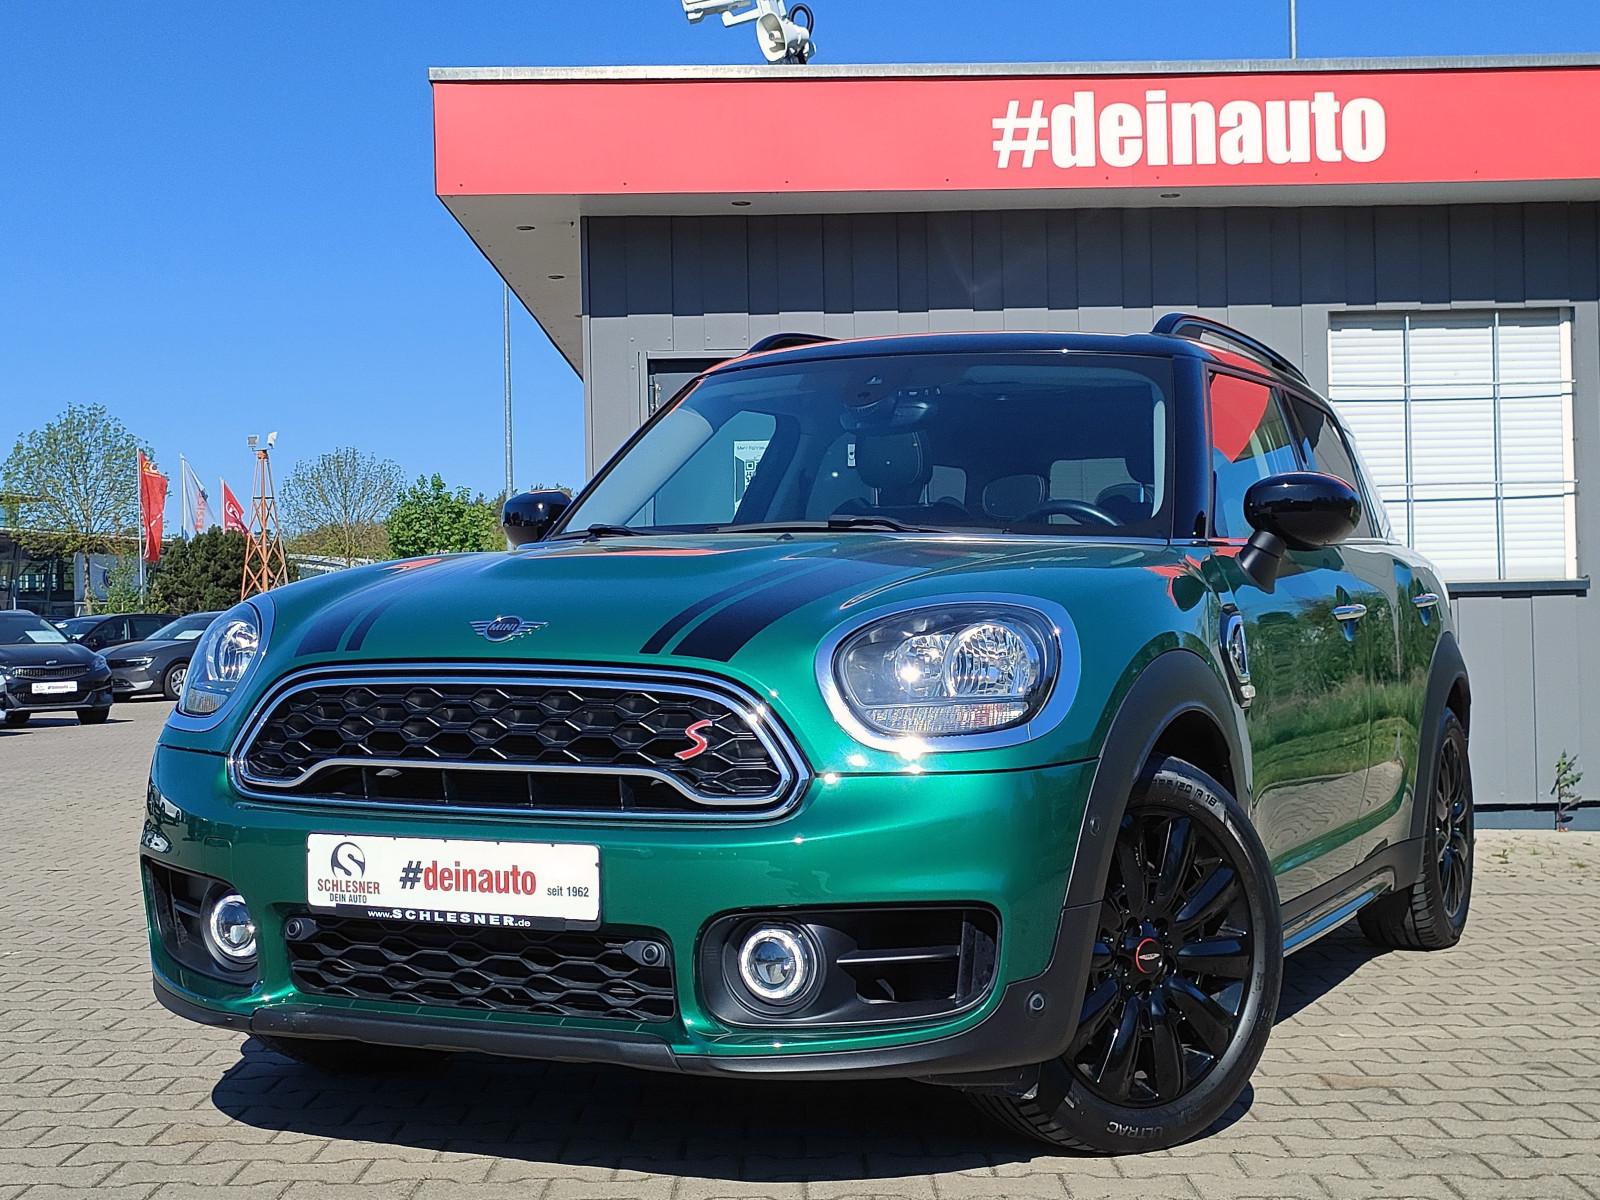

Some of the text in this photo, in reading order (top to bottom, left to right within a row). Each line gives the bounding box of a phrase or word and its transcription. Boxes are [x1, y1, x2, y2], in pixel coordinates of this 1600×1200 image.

[991, 89, 1386, 169] #deinauto
[674, 719, 713, 760] S
[317, 878, 381, 894] SCHLESNER
[399, 860, 537, 896] #deinauto
[329, 893, 368, 904] DEIN AUTO
[547, 885, 589, 898] seit 1962
[368, 908, 531, 928] www.SCHLESNER.de
[1106, 1121, 1164, 1139] ULTRAC
